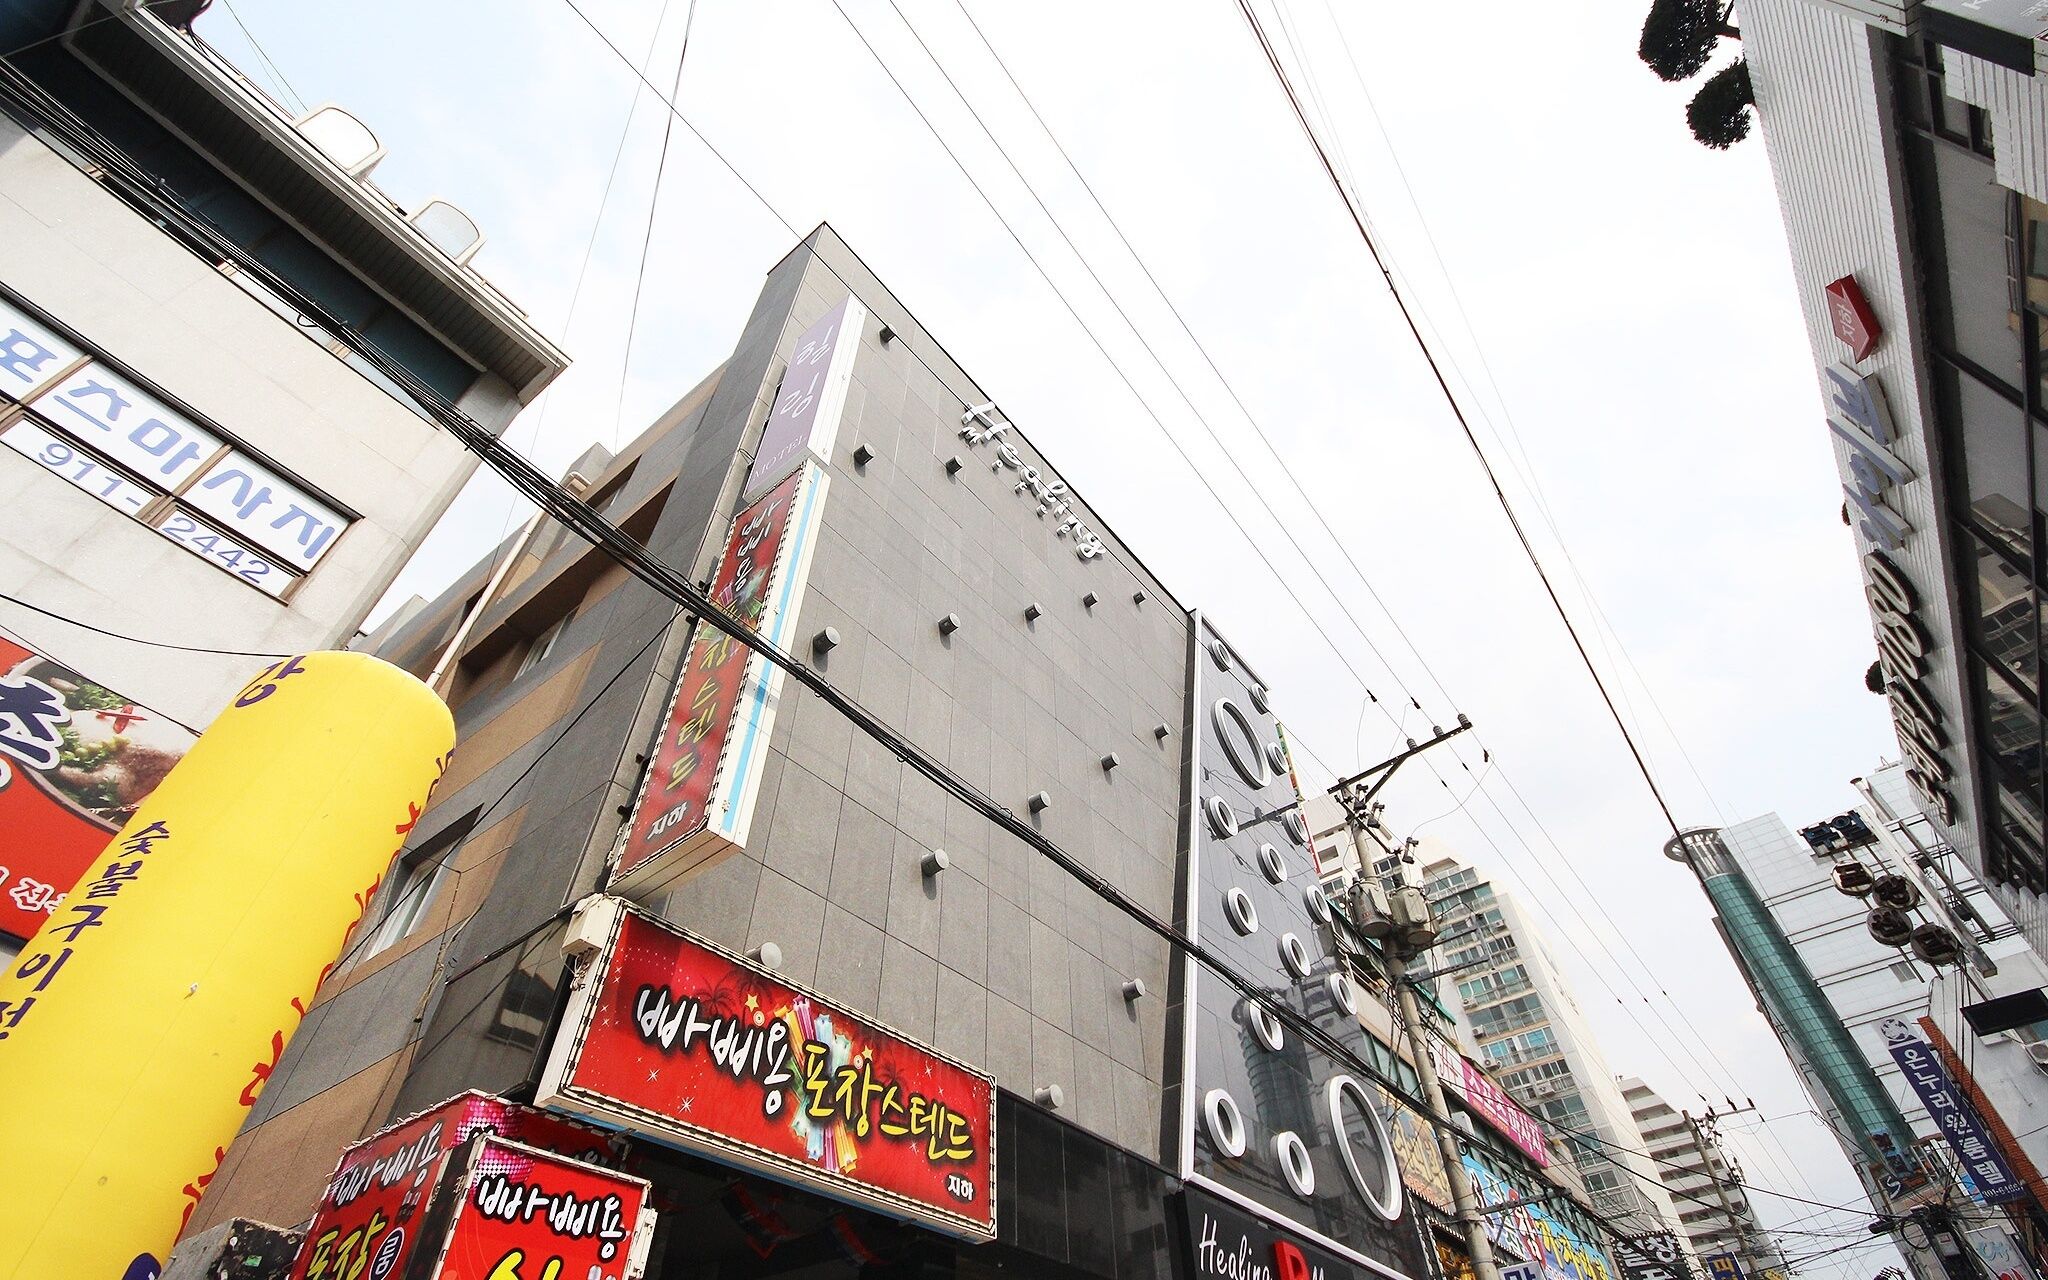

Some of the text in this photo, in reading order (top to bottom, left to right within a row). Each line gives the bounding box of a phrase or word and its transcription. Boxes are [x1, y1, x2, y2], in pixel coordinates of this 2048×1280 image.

[1836, 302, 1856, 342] 지하
[38, 443, 271, 583] 911- 2442
[960, 401, 1107, 558] Healing
[735, 499, 783, 592] 빠삐용
[648, 802, 687, 839] 지하
[637, 988, 974, 1160] 빠삐용 포장스텐드
[336, 1122, 442, 1206] 빠삐용
[947, 1175, 974, 1201] 지하
[478, 1178, 623, 1259] 빠삐용
